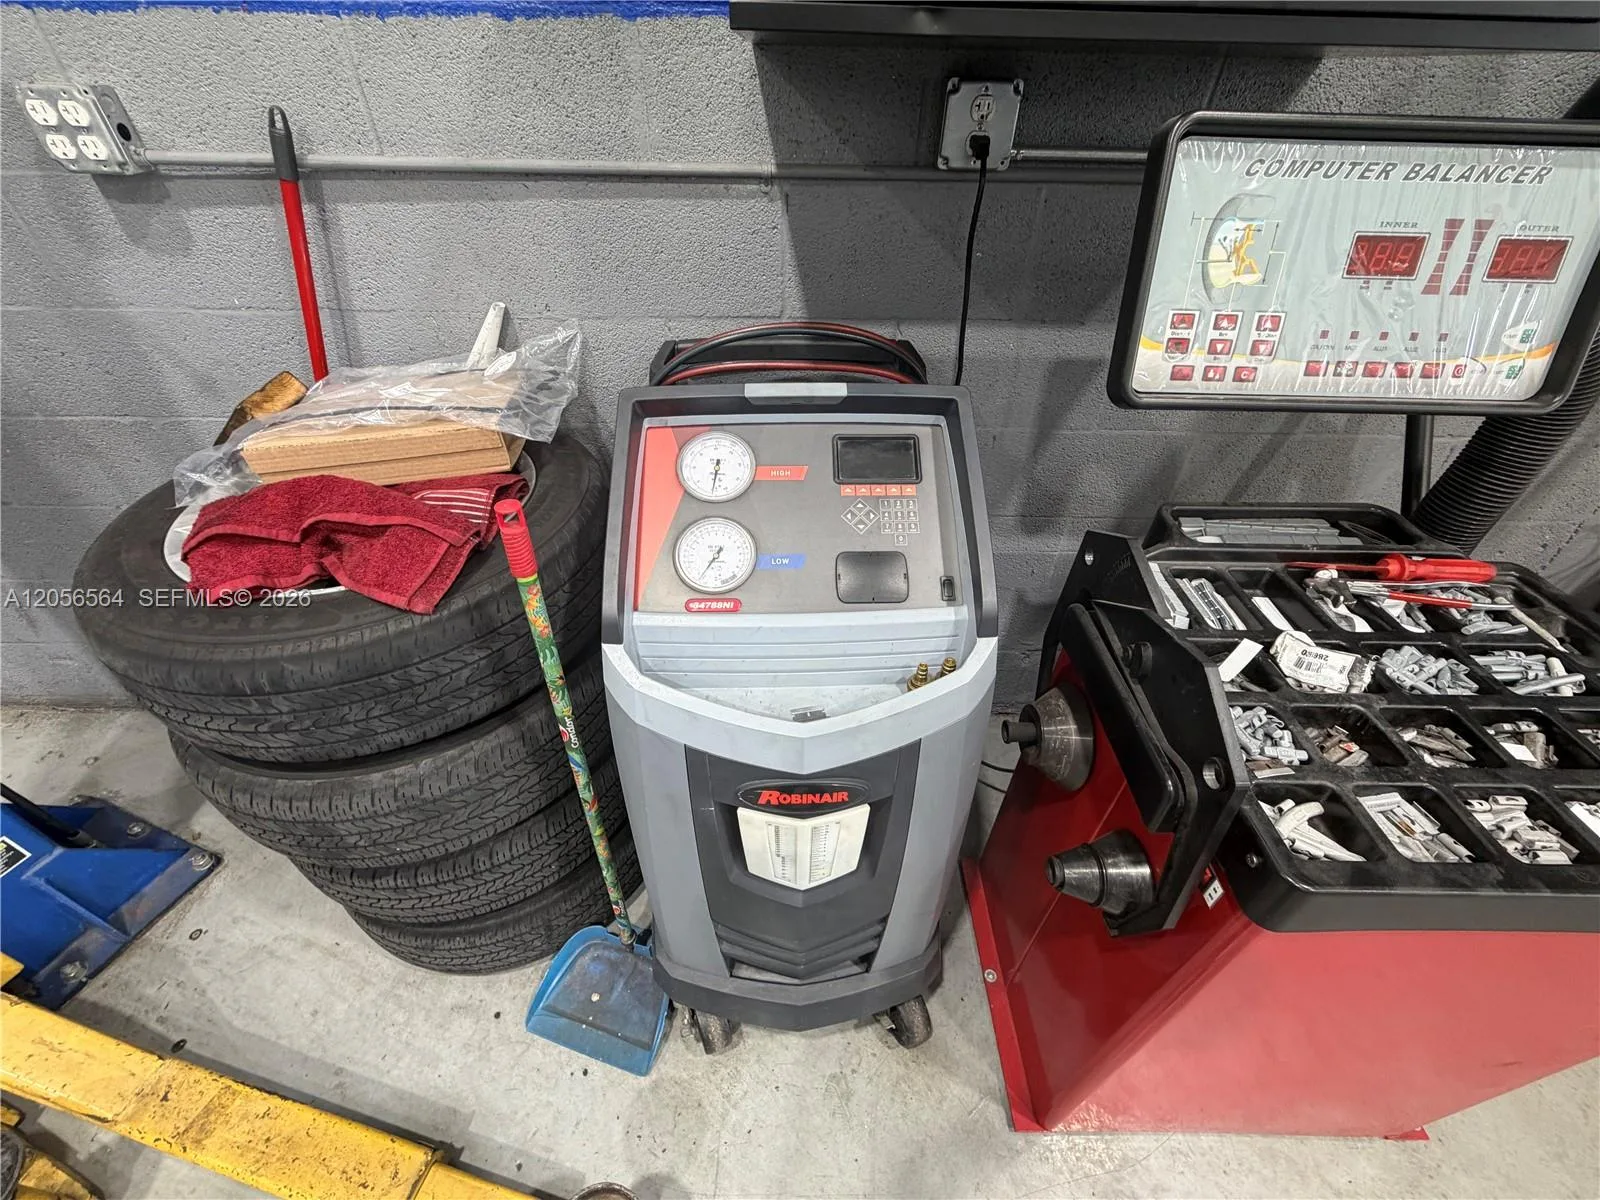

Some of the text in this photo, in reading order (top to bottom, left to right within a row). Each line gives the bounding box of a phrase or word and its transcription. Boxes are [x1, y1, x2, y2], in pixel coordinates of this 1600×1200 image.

[1244, 158, 1553, 185] COMPUTER BALANCER
[1379, 221, 1419, 229] INNER
[1519, 224, 1560, 233] OUTER
[770, 469, 791, 477] HIGH
[771, 557, 790, 565] LOW
[564, 716, 580, 749] Condor
[757, 789, 849, 806] ROBINAIR
